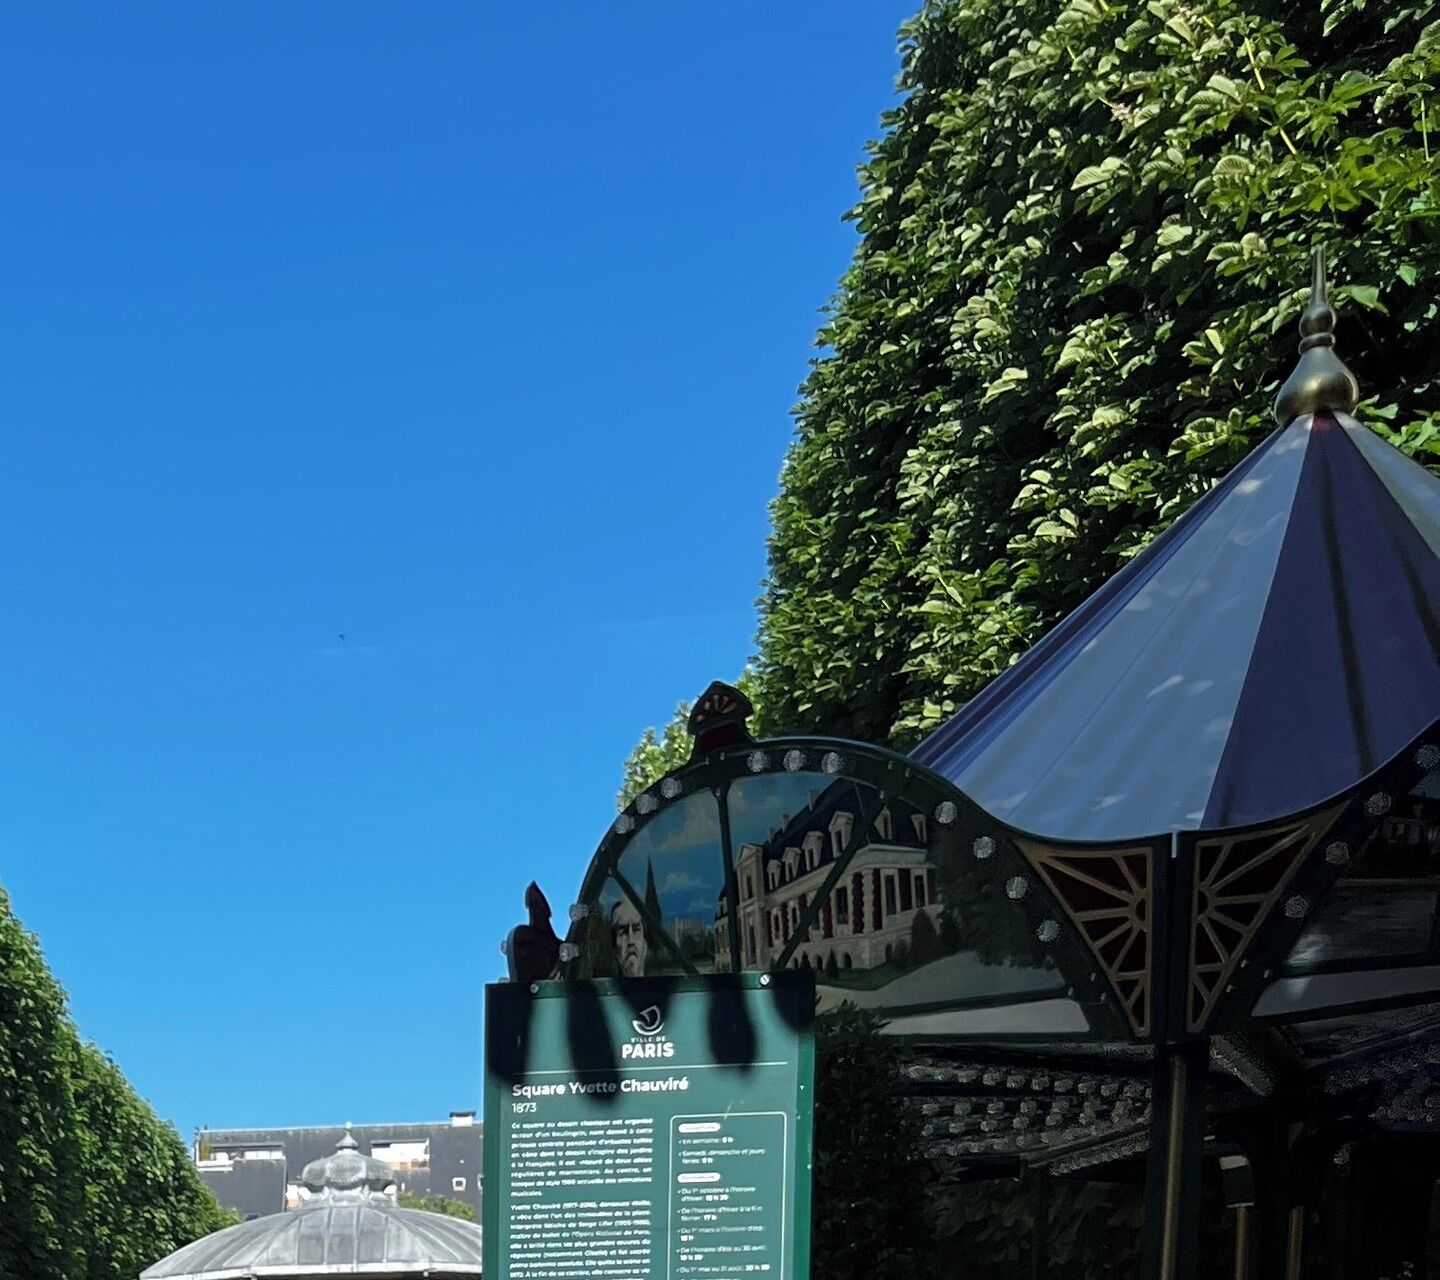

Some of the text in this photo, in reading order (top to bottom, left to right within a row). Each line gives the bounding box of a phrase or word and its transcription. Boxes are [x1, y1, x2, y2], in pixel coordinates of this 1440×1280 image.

[621, 1042, 674, 1059] PARIS
[512, 1077, 689, 1099] Square Yvette Chauviré
[512, 1102, 537, 1113] 1873
